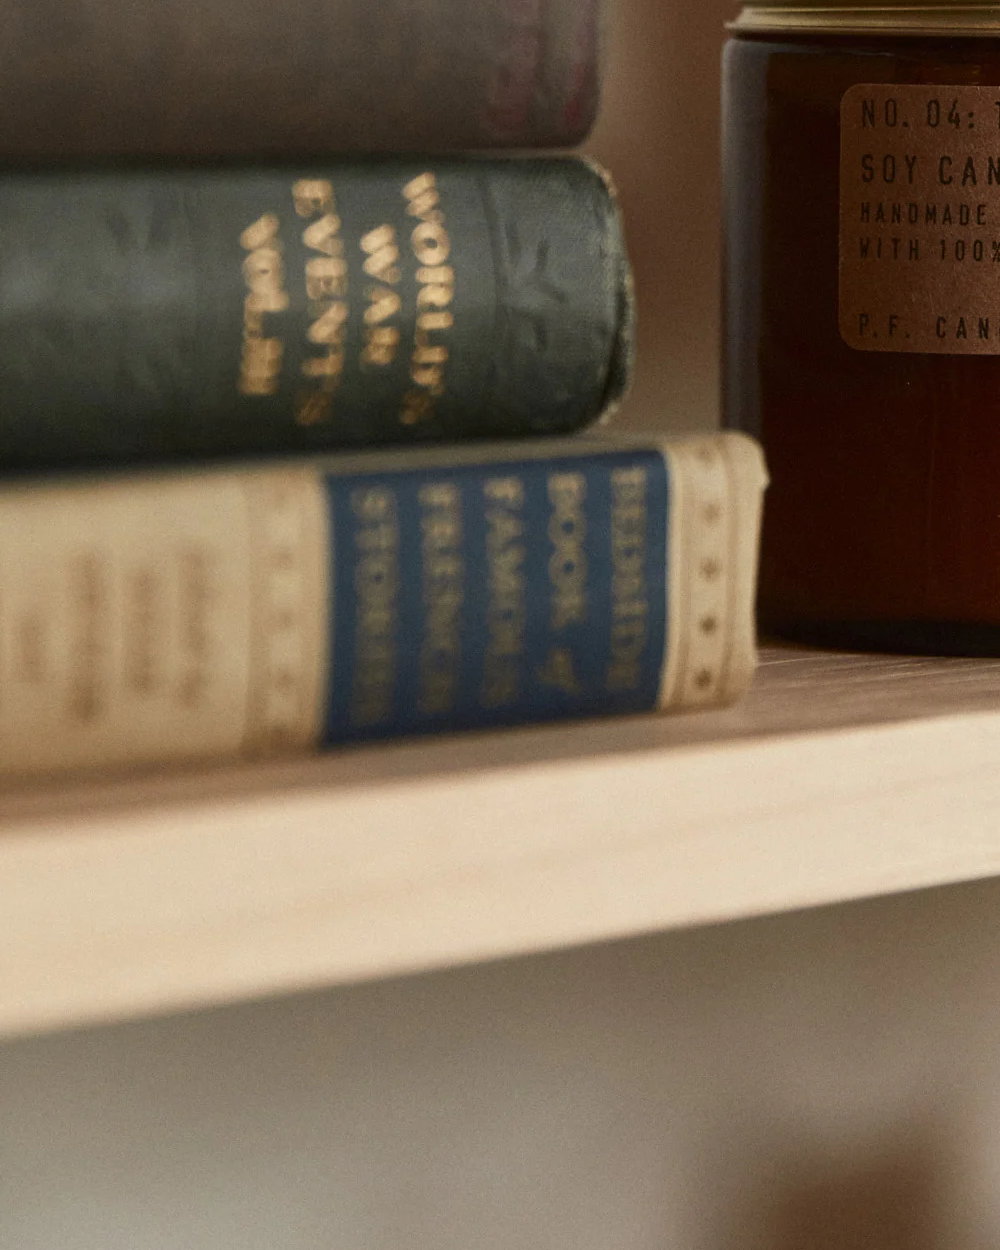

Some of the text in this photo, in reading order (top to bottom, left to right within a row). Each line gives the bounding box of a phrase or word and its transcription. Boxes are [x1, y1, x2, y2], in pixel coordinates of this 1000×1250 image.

[862, 99, 909, 128] NO.
[927, 99, 974, 129] 04:
[861, 154, 917, 185] SOY
[860, 202, 987, 226] HANDMADE
[860, 237, 919, 261] WITH
[360, 223, 401, 370] WAR
